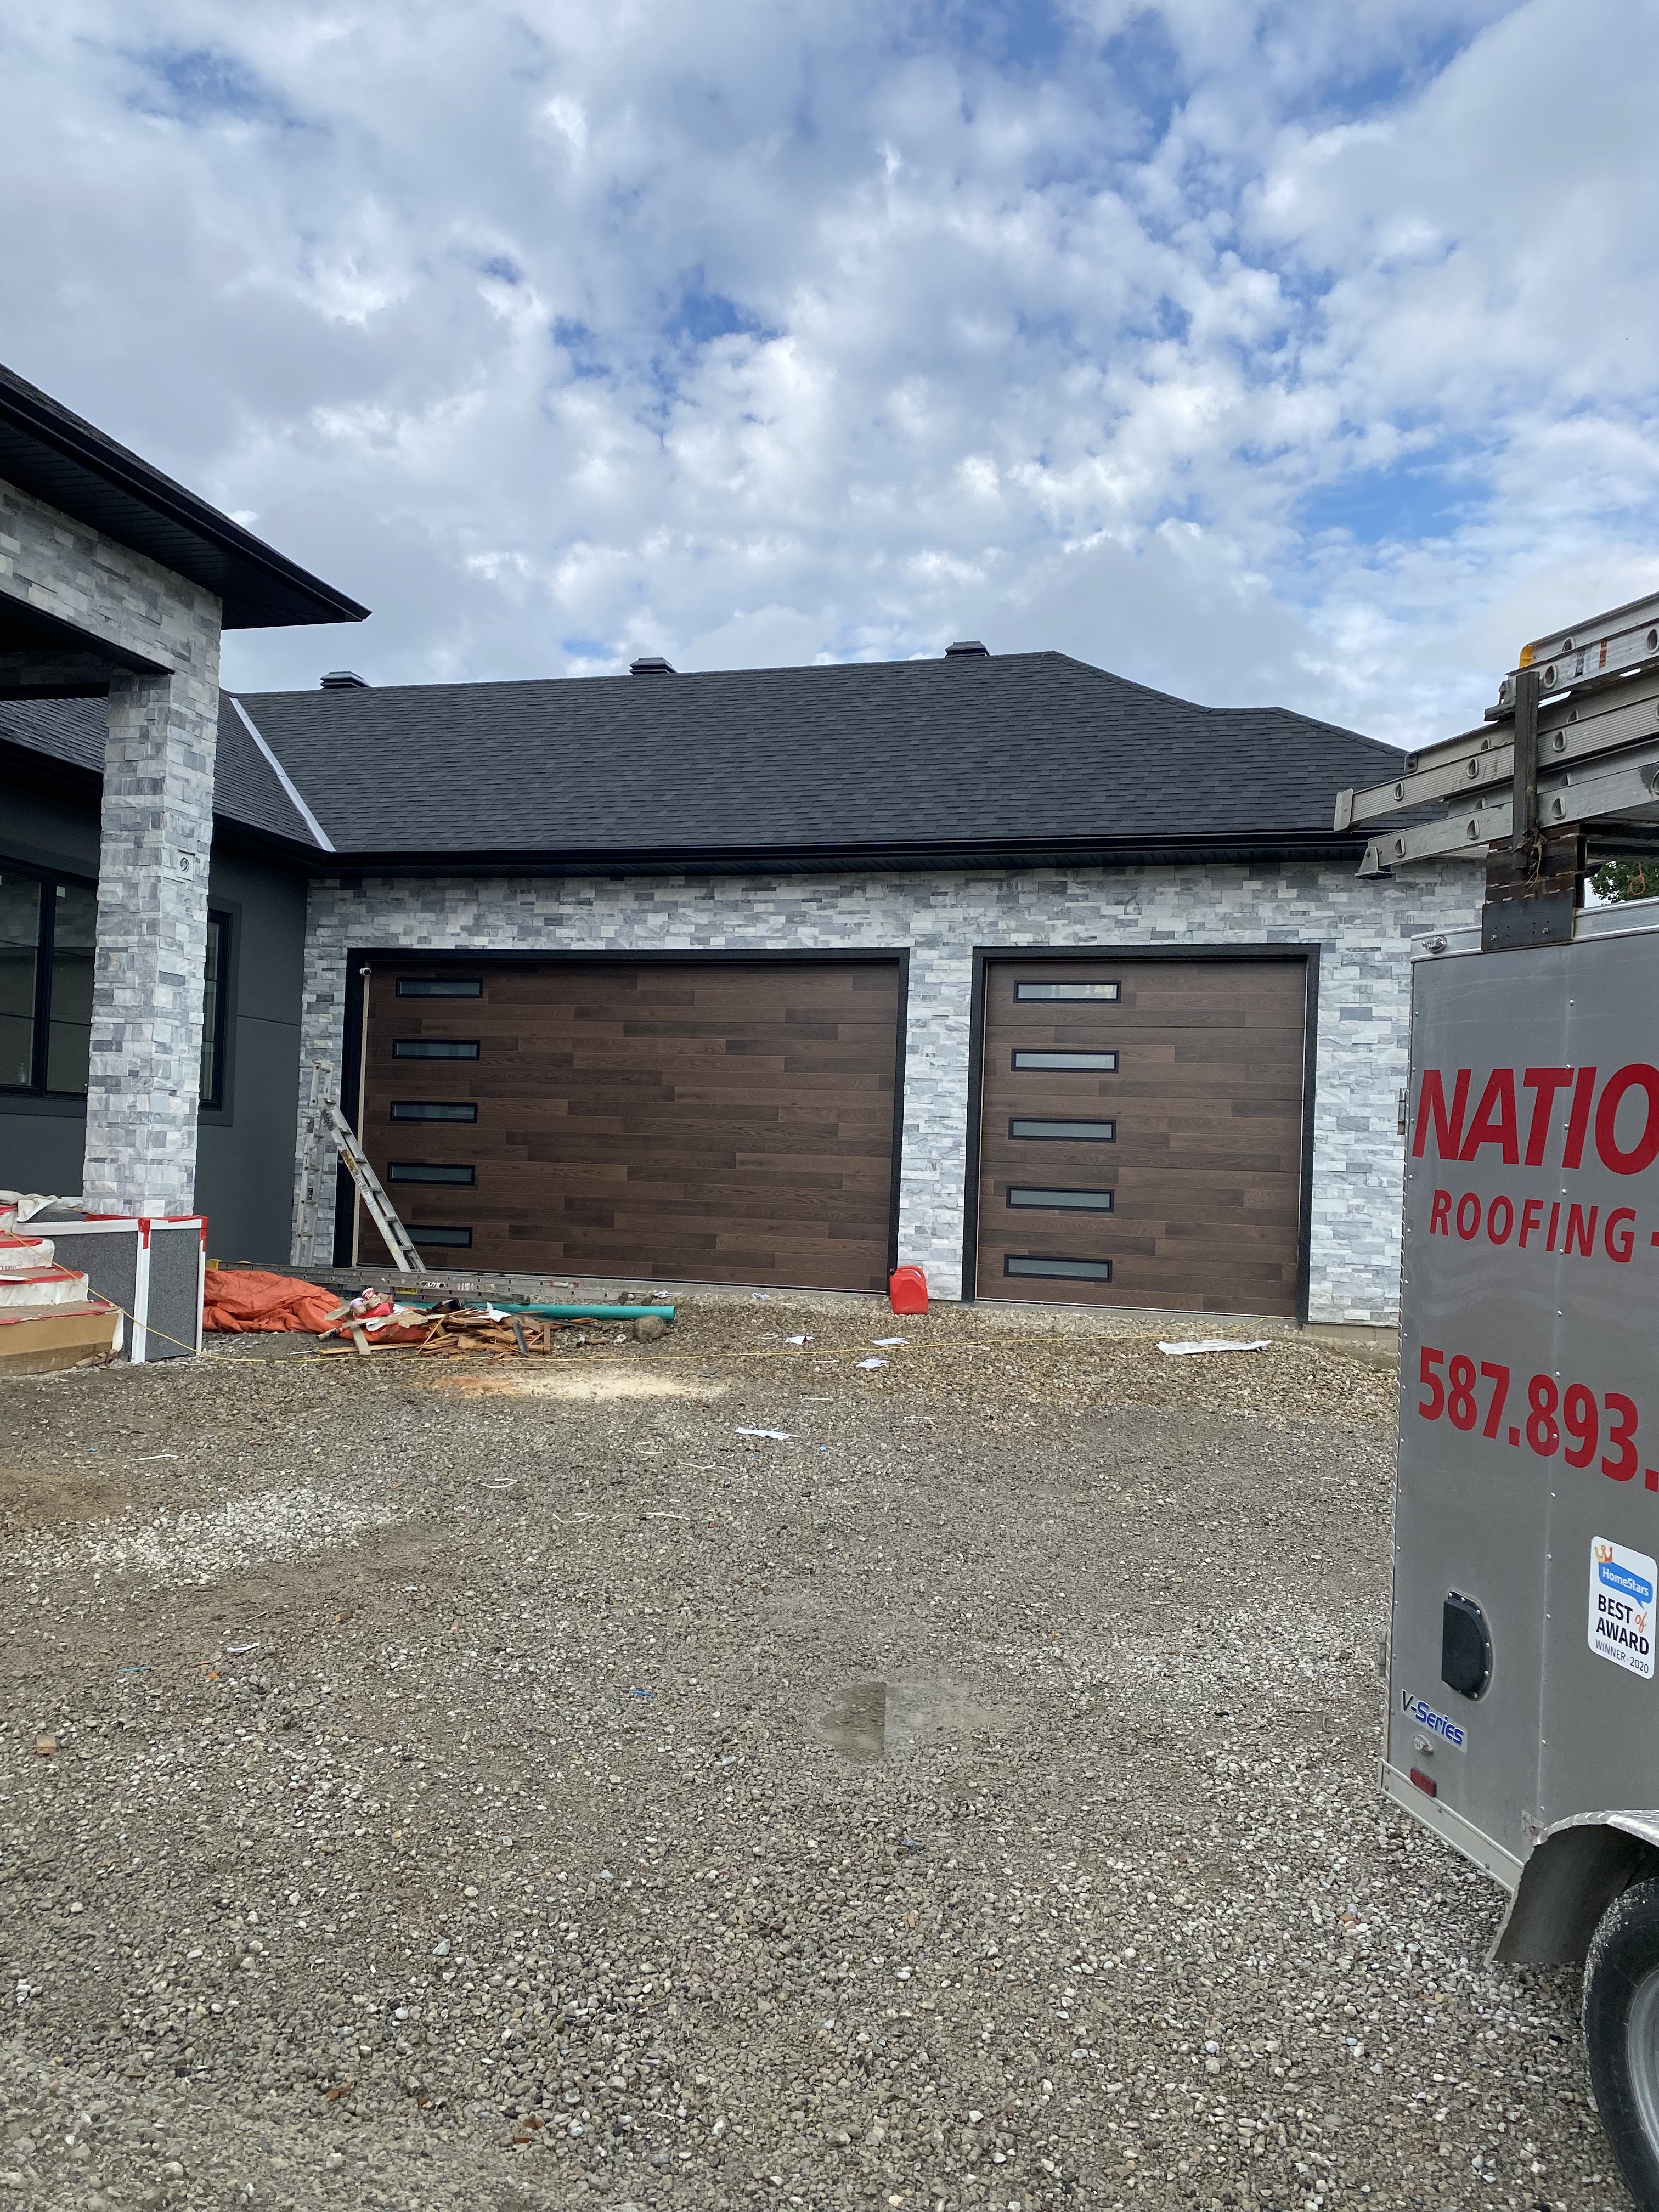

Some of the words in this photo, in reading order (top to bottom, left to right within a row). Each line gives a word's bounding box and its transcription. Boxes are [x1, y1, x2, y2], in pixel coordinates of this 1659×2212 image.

[1412, 1063, 1659, 1175] NATIO
[1430, 1189, 1637, 1263] ROOFING
[1602, 1567, 1649, 1596] HomeStars
[1598, 1594, 1633, 1624] BEST
[1635, 1611, 1647, 1633] of
[1596, 1617, 1649, 1655] AWARD
[1595, 1639, 1626, 1662] WINNER
[1630, 1656, 1649, 1673] 2020
[1402, 1689, 1465, 1745] V-Series
